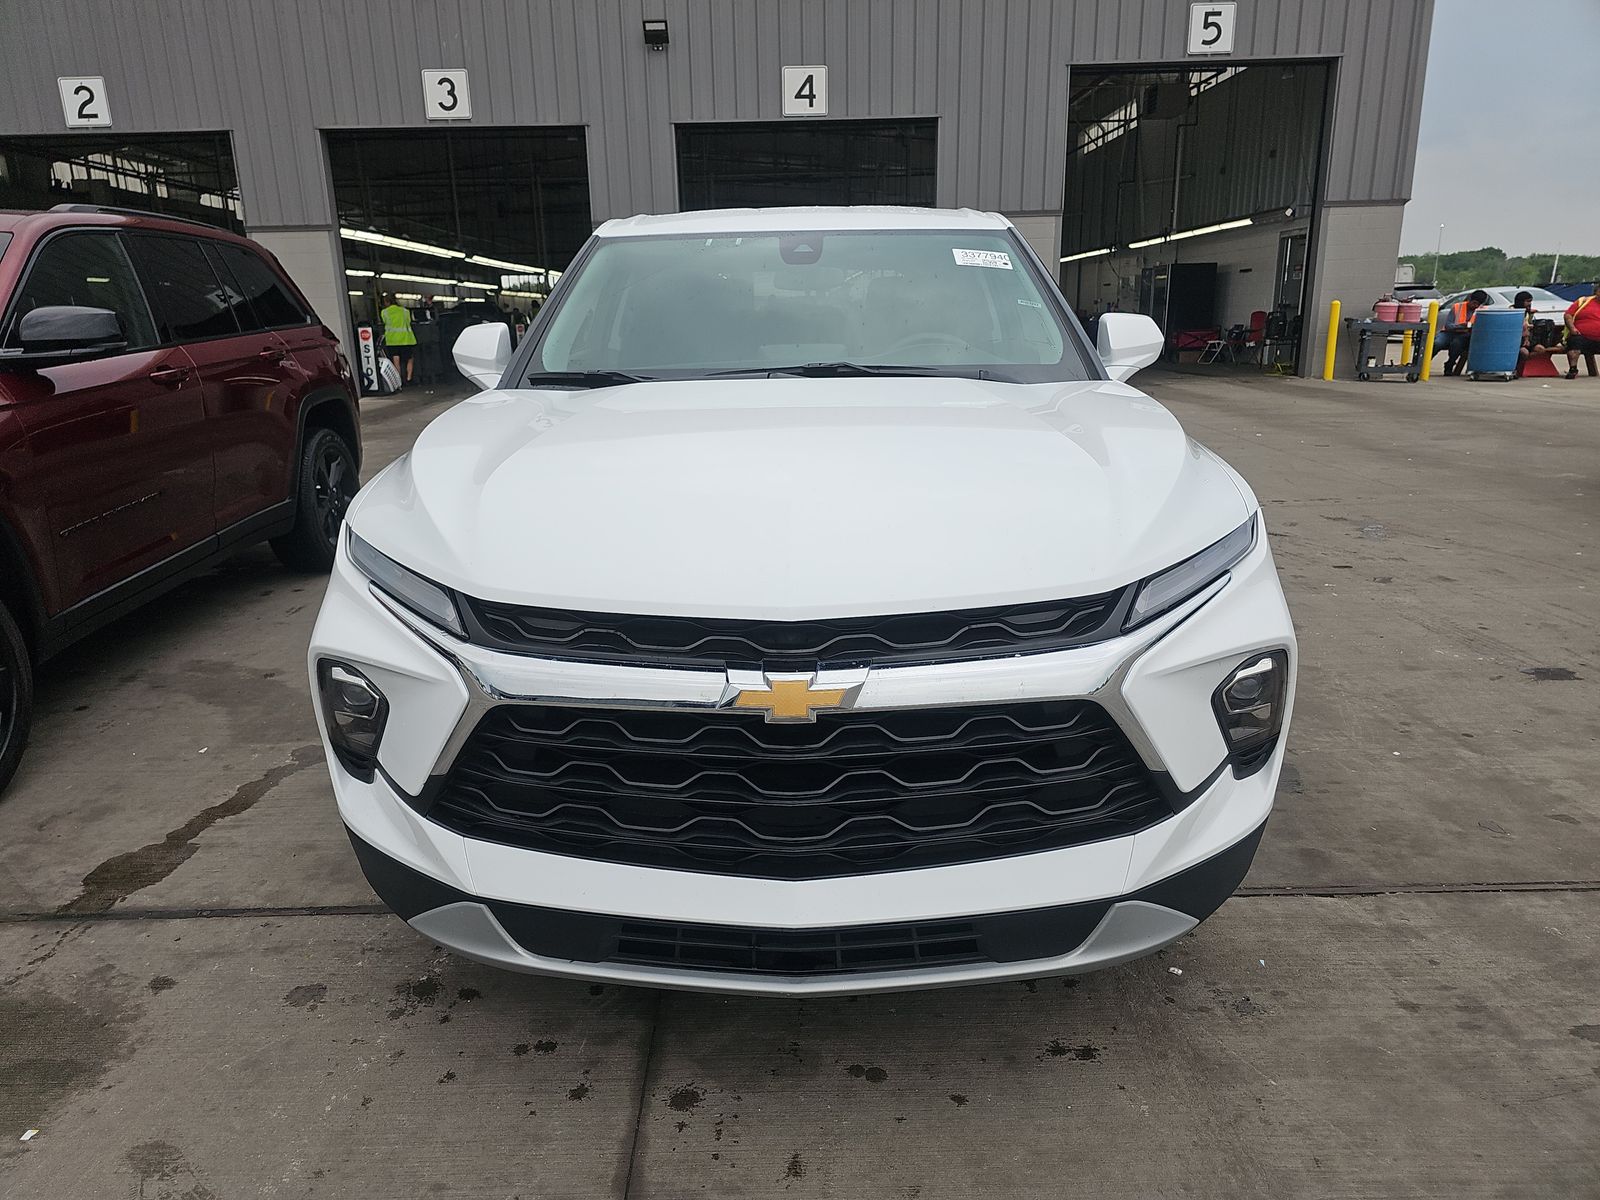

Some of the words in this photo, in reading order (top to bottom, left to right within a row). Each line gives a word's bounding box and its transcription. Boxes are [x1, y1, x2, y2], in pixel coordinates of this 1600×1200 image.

[1201, 10, 1223, 46] 5
[73, 85, 99, 120] 2
[437, 77, 458, 112] 3
[794, 74, 817, 108] 4
[363, 344, 376, 387] STO
